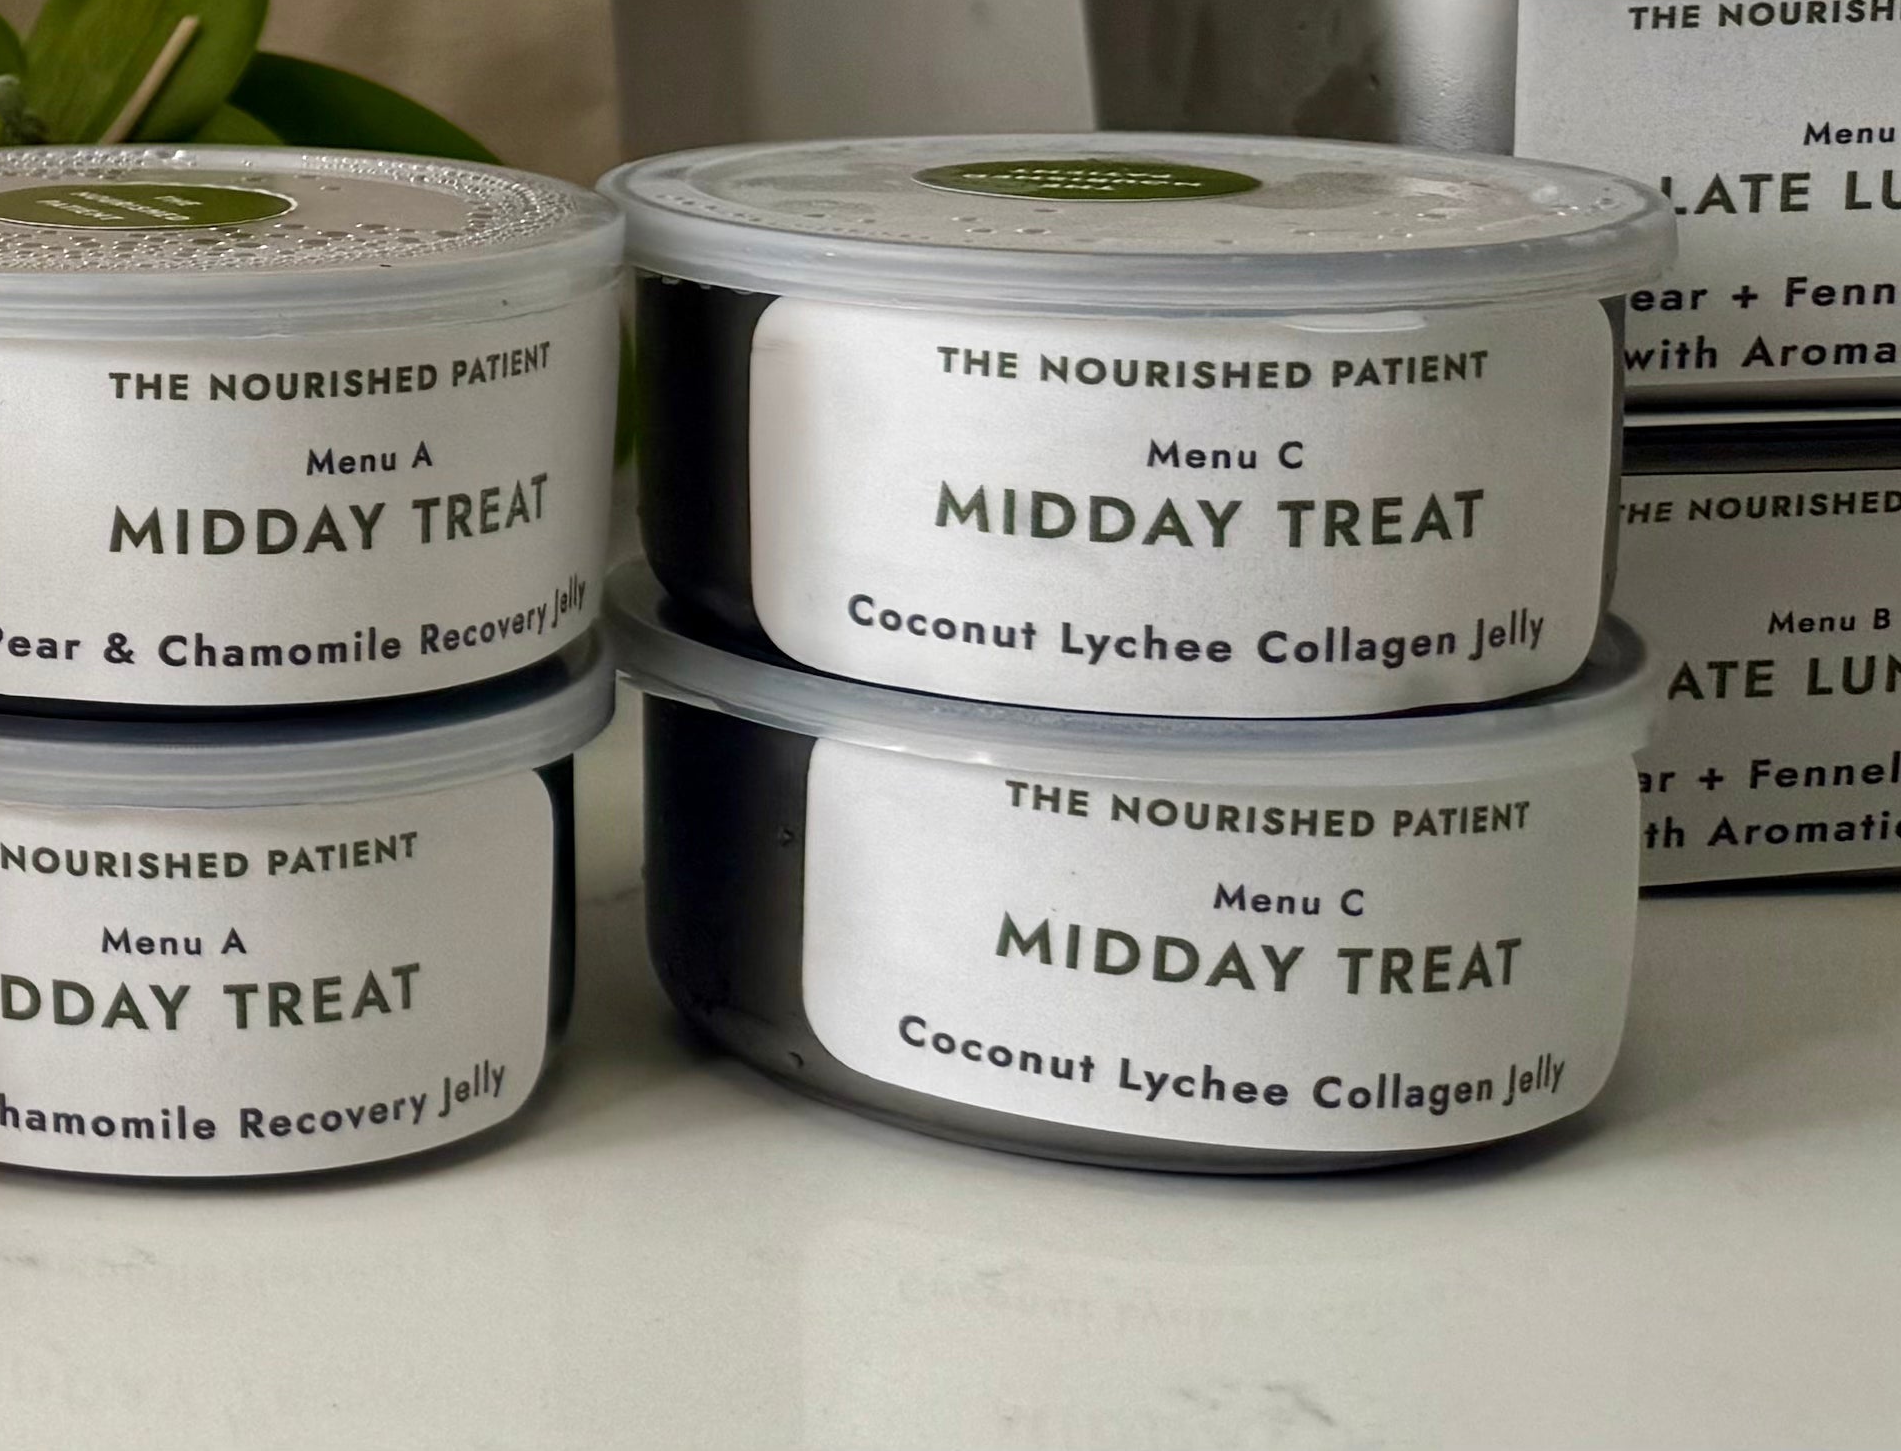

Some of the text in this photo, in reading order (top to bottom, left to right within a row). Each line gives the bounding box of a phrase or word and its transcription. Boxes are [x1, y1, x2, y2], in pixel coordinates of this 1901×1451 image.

[1629, 5, 1700, 30] THE
[1804, 122, 1895, 145] Menu
[109, 341, 550, 401] THE NOURISHED PATIENT
[937, 347, 1487, 389] THE NOURISHED PATIENT
[1624, 335, 1717, 370] with
[307, 441, 432, 476] Menu A
[1147, 440, 1303, 469] Menu C
[109, 473, 547, 555] MIDDAY TREAT
[935, 481, 1484, 548] MIDDAY TREAT
[104, 633, 134, 664] &
[158, 627, 401, 667] Chamomile
[421, 603, 547, 654] Recovery
[552, 574, 586, 629] Jelly
[849, 594, 1543, 669] Coconut Lychee Collagen Jelly
[1768, 608, 1890, 634] Menu B
[1750, 751, 1901, 789] Fennel
[899, 1015, 1565, 1116] Coconut Lychee Collagen Jelly
[240, 1093, 426, 1139] Recovery
[438, 1060, 505, 1118] Jelly
